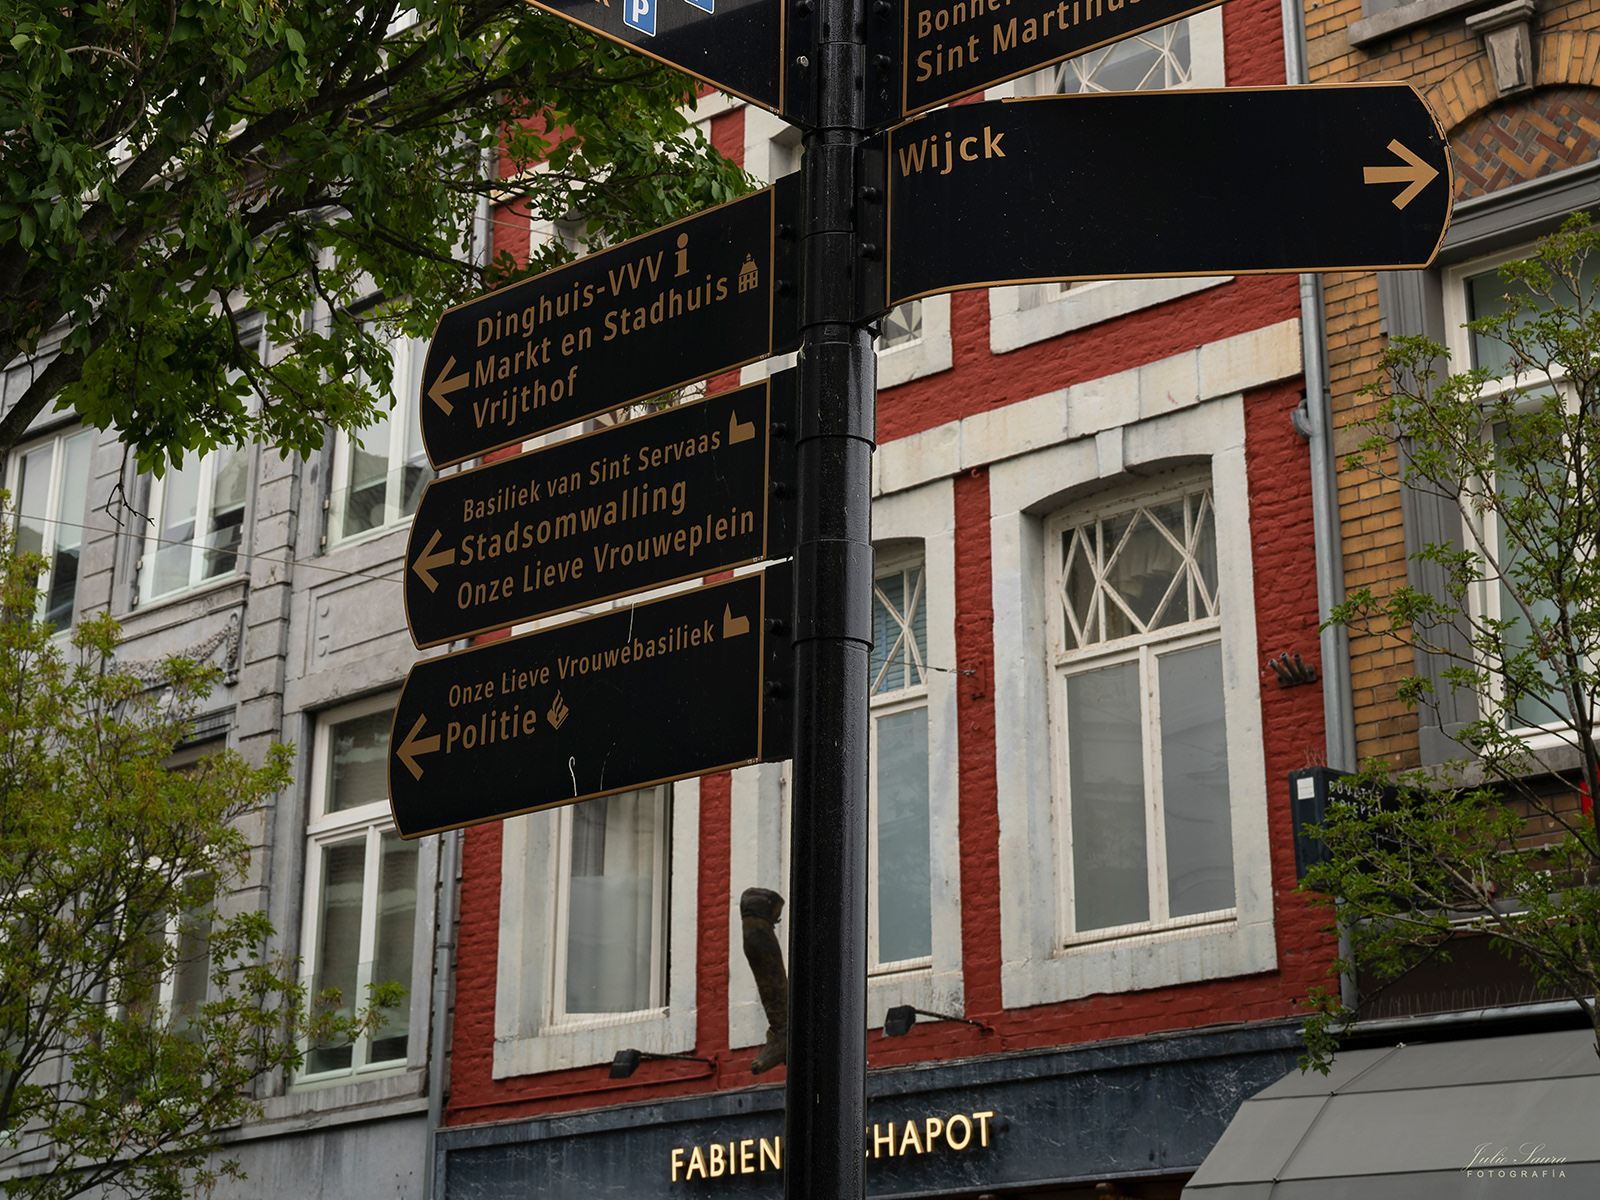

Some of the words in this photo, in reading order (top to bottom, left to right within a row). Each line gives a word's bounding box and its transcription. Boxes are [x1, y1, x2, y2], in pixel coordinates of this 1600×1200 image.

[916, 34, 979, 83] Sint
[899, 126, 1005, 177] Wijck
[474, 338, 551, 389] Markt
[561, 327, 592, 357] en
[603, 275, 728, 342] Stadhuis
[477, 250, 663, 348] Dinghuis-VVV
[473, 365, 579, 429] Vrijthof
[463, 480, 540, 522] Basiliek
[547, 469, 581, 496] van
[588, 453, 630, 486] Sint
[638, 429, 721, 471] Servaas
[457, 575, 513, 610] Onze
[523, 554, 583, 593] Lieve
[594, 509, 754, 573] Vrouweplein
[460, 480, 687, 566] Stadsomwalling
[448, 681, 494, 707] Onze
[501, 665, 550, 695] Lieve
[558, 619, 715, 680] Vrouwebasiliek
[446, 705, 537, 754] Politie
[671, 1135, 783, 1182] FABIEN
[866, 1110, 994, 1159] HAPOT
